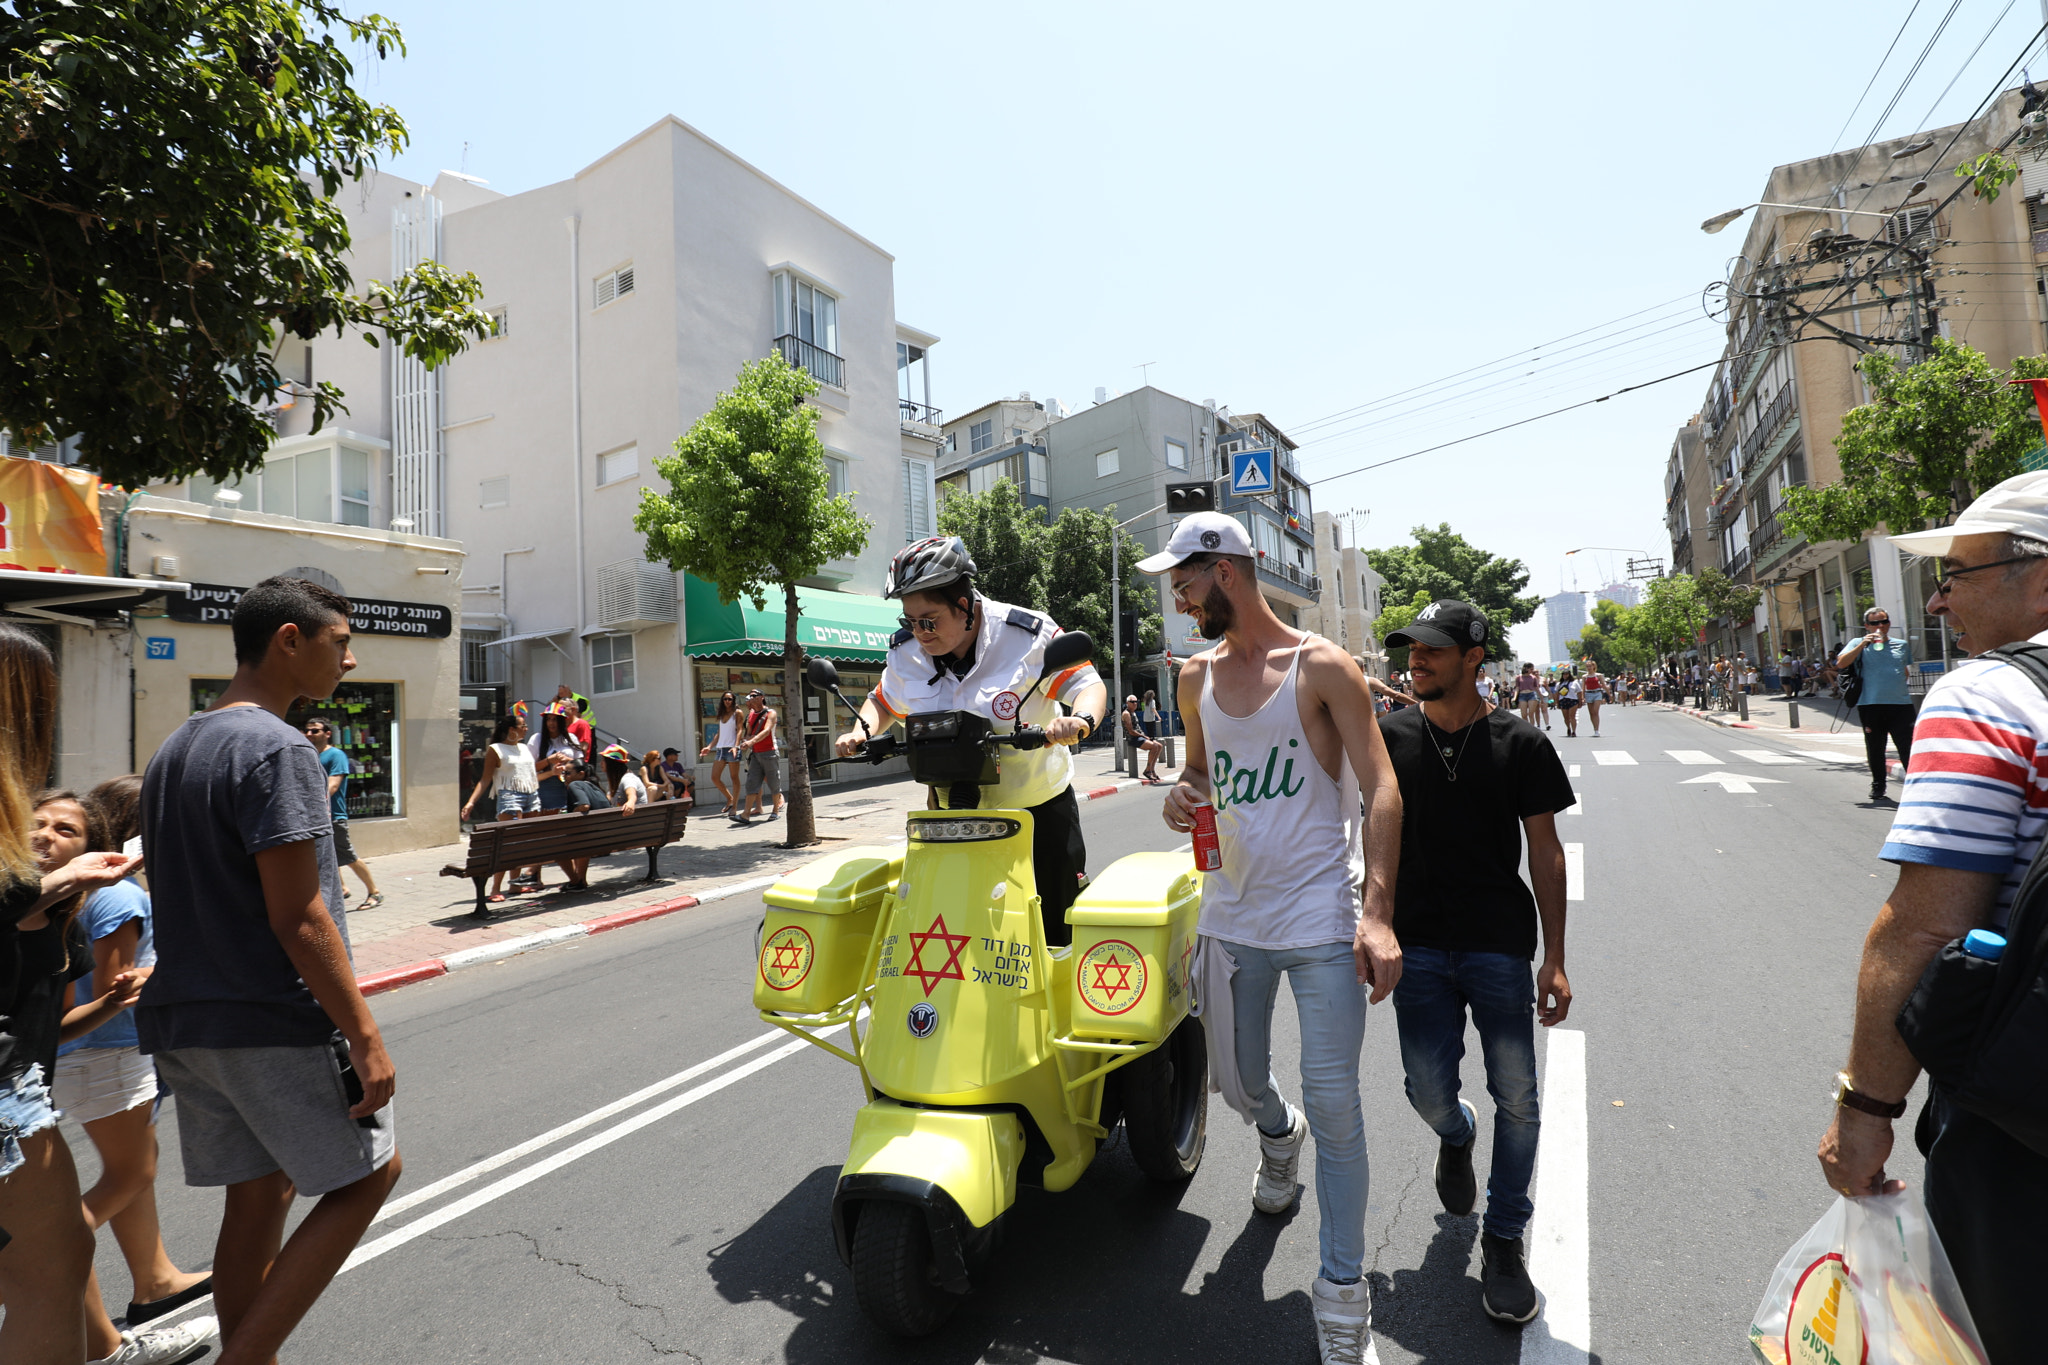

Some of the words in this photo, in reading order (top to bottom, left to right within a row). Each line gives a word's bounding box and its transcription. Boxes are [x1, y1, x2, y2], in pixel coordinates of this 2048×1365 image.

[402, 607, 442, 620] מותגי
[373, 619, 428, 633] תוספות
[812, 625, 861, 645] ספרים
[151, 641, 171, 656] 57
[980, 937, 1004, 953] דוד
[1010, 942, 1032, 958] מגן
[1107, 944, 1126, 952] אדום
[880, 966, 899, 978] ISRAEL
[995, 956, 1030, 974] אדום
[972, 966, 1028, 990] בישראל
[1081, 969, 1090, 995] MAGEN
[1087, 995, 1106, 1010] DAVID
[1106, 1001, 1128, 1011] ADOM
[1127, 995, 1135, 1003] IN
[1132, 973, 1143, 997] ISRAEL
